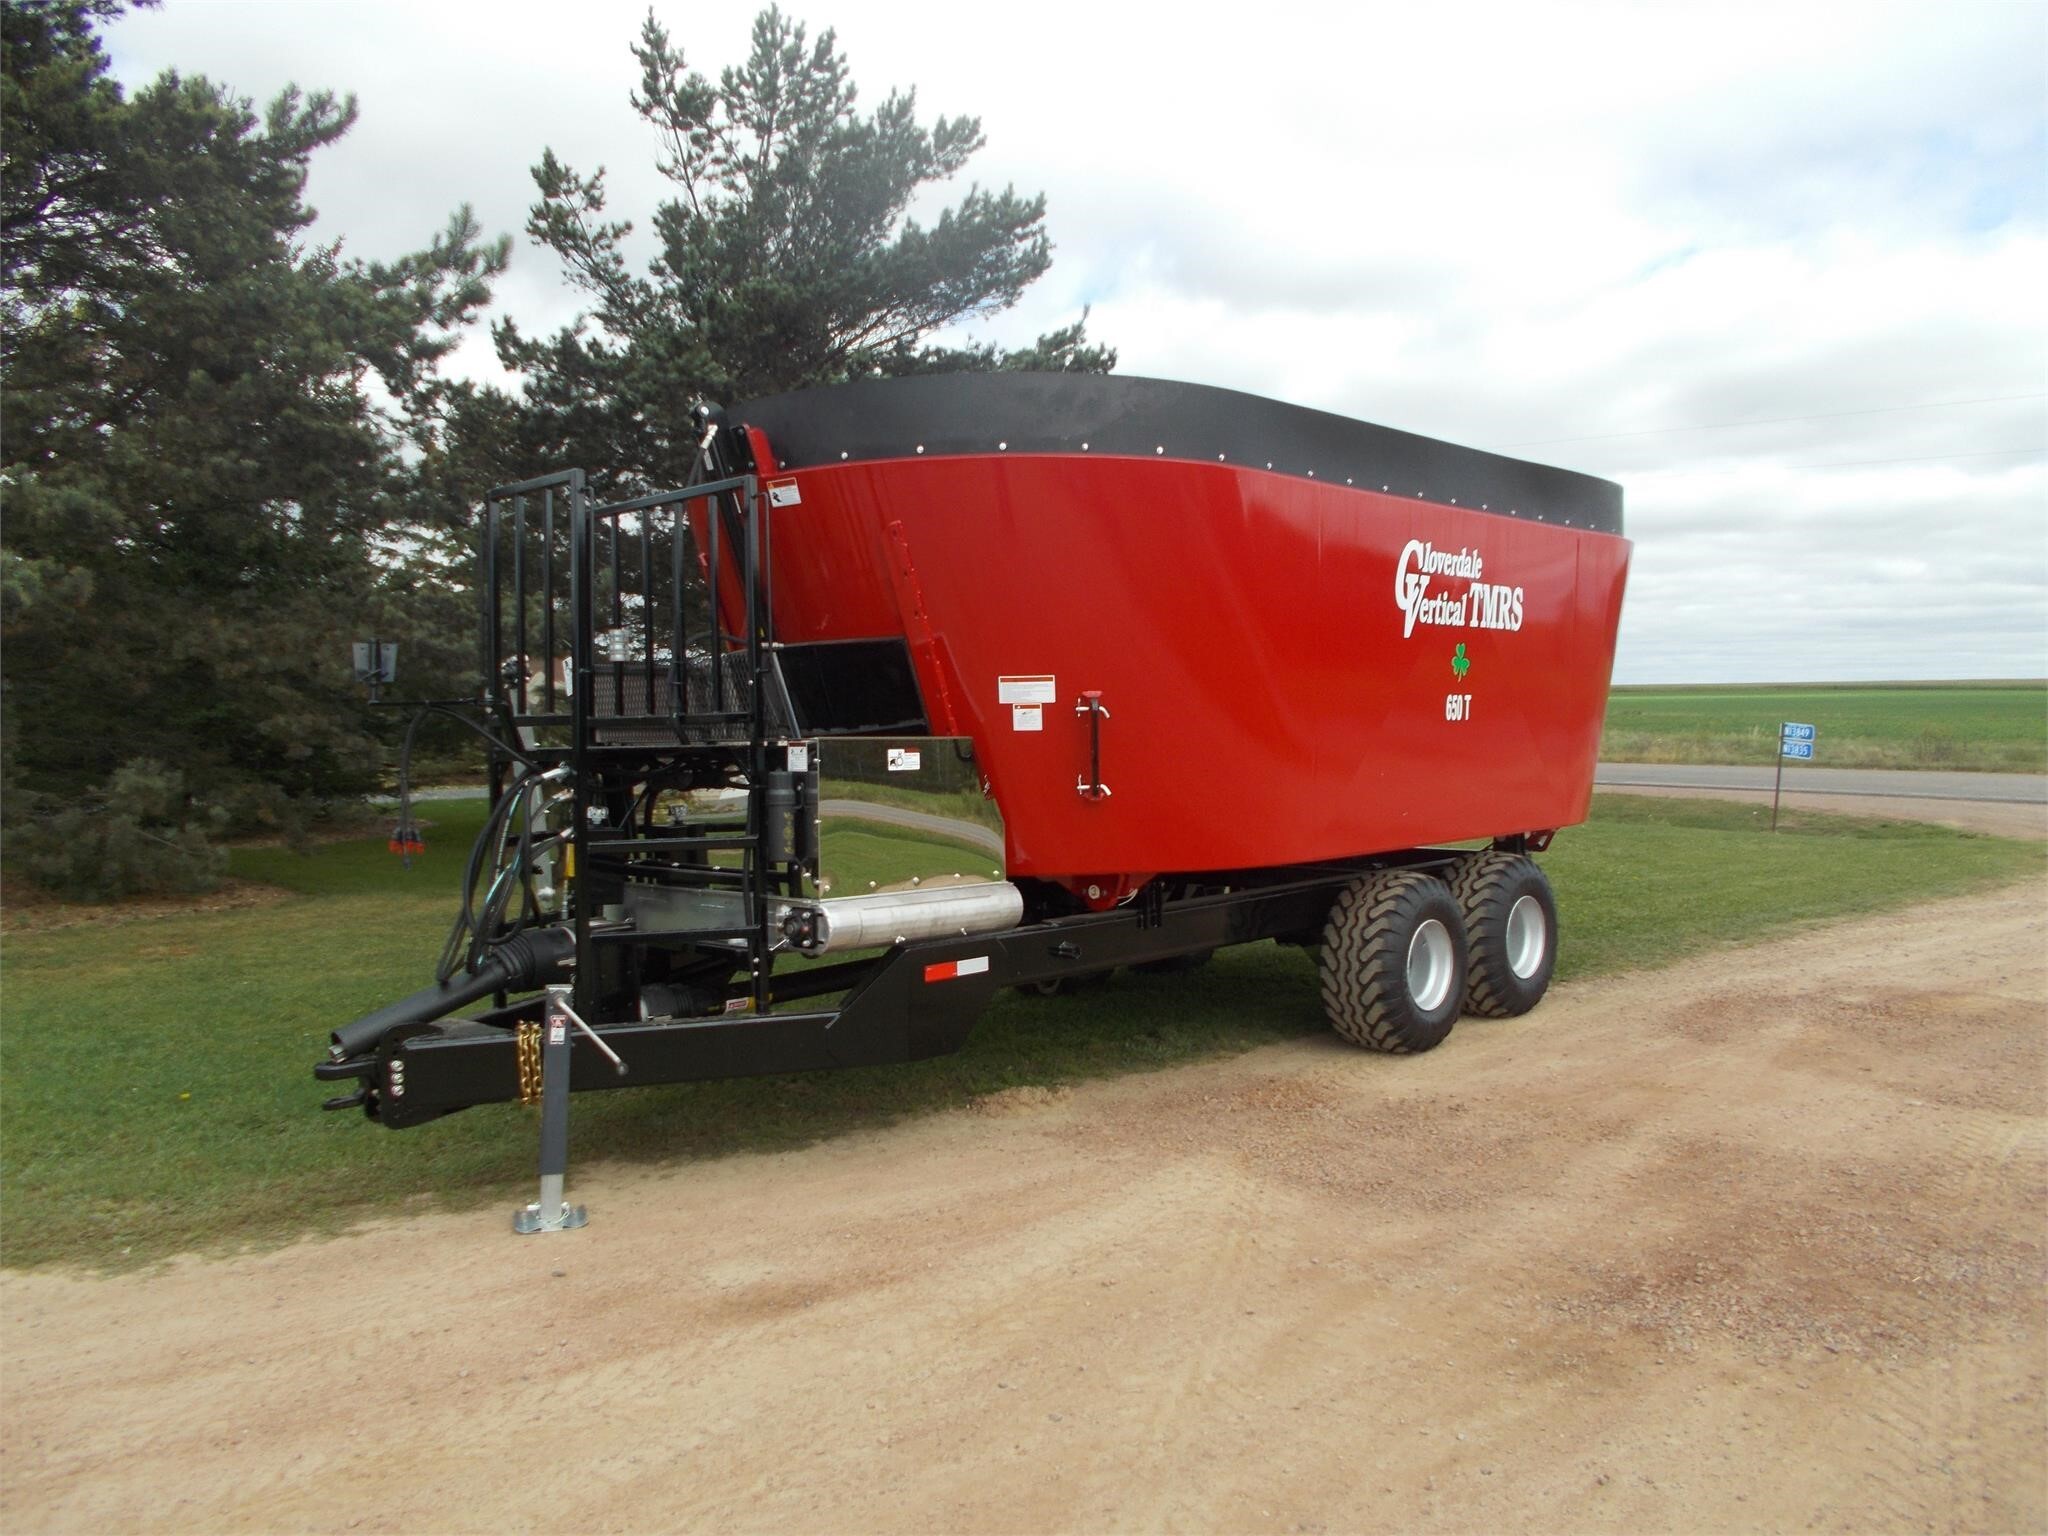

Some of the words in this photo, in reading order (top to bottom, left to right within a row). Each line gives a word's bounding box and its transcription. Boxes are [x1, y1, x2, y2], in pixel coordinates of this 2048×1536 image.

[1395, 539, 1483, 610] Cloverdale
[1403, 573, 1466, 638] Vertical
[1469, 582, 1523, 631] TMRS
[1446, 694, 1463, 721] 650
[1464, 694, 1472, 720] T
